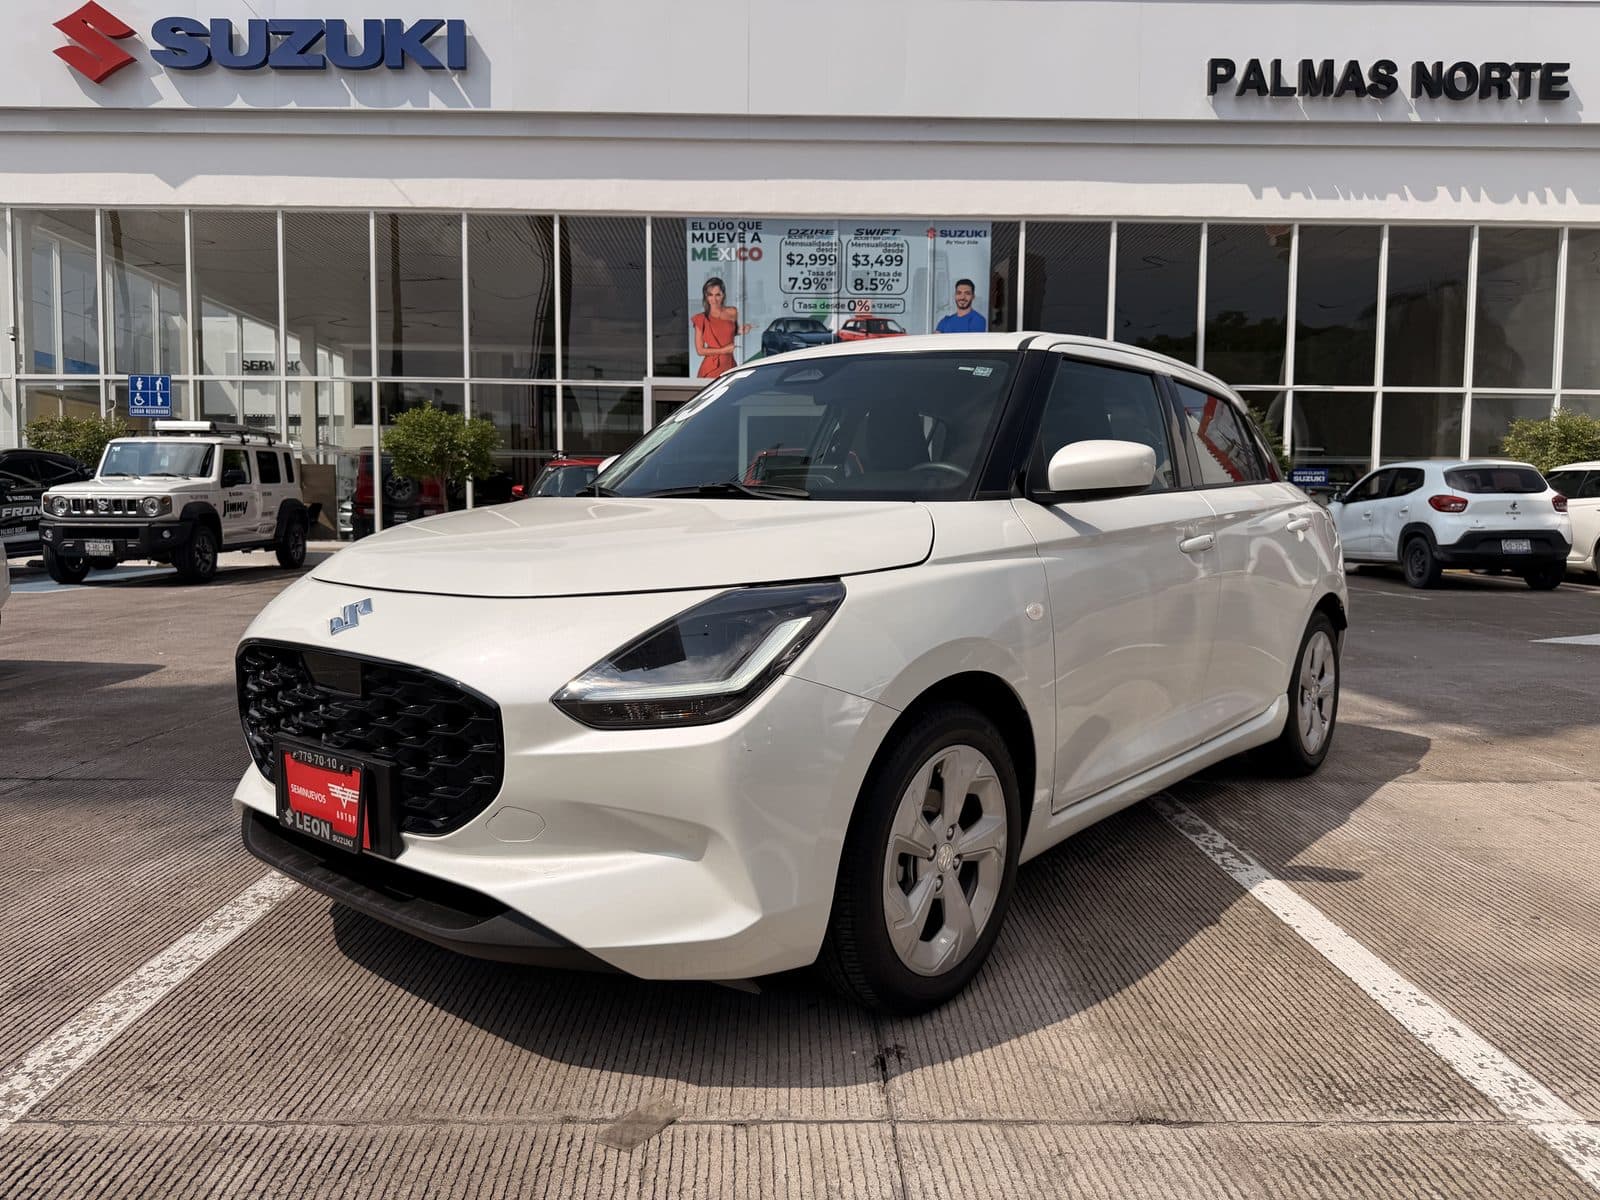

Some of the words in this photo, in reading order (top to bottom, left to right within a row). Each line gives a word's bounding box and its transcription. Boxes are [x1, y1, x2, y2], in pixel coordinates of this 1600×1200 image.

[150, 17, 467, 71] SUZUKI
[1207, 58, 1399, 99] PALMAS
[1411, 61, 1571, 101] NORTE
[691, 221, 705, 230] EL
[708, 219, 735, 230] DÚO
[737, 221, 763, 232] QUE
[788, 228, 835, 236] DZIRE
[854, 228, 901, 236] SWIFT
[691, 232, 746, 243] MUEVE
[750, 232, 762, 244] A
[940, 229, 987, 238] SUZUKI
[851, 241, 905, 249] Mensualidades
[691, 244, 763, 261] MÉXICO
[786, 251, 837, 268] $2,999
[851, 252, 904, 269] $3,499
[892, 270, 903, 278] de
[798, 302, 817, 310] Tasa
[847, 299, 870, 312] 0%
[1292, 475, 1326, 483] SUZUKI
[1, 505, 42, 518] FRON
[222, 500, 249, 518] Jimny
[291, 783, 326, 804] SEMINUEVOS
[296, 812, 330, 840] LEON
